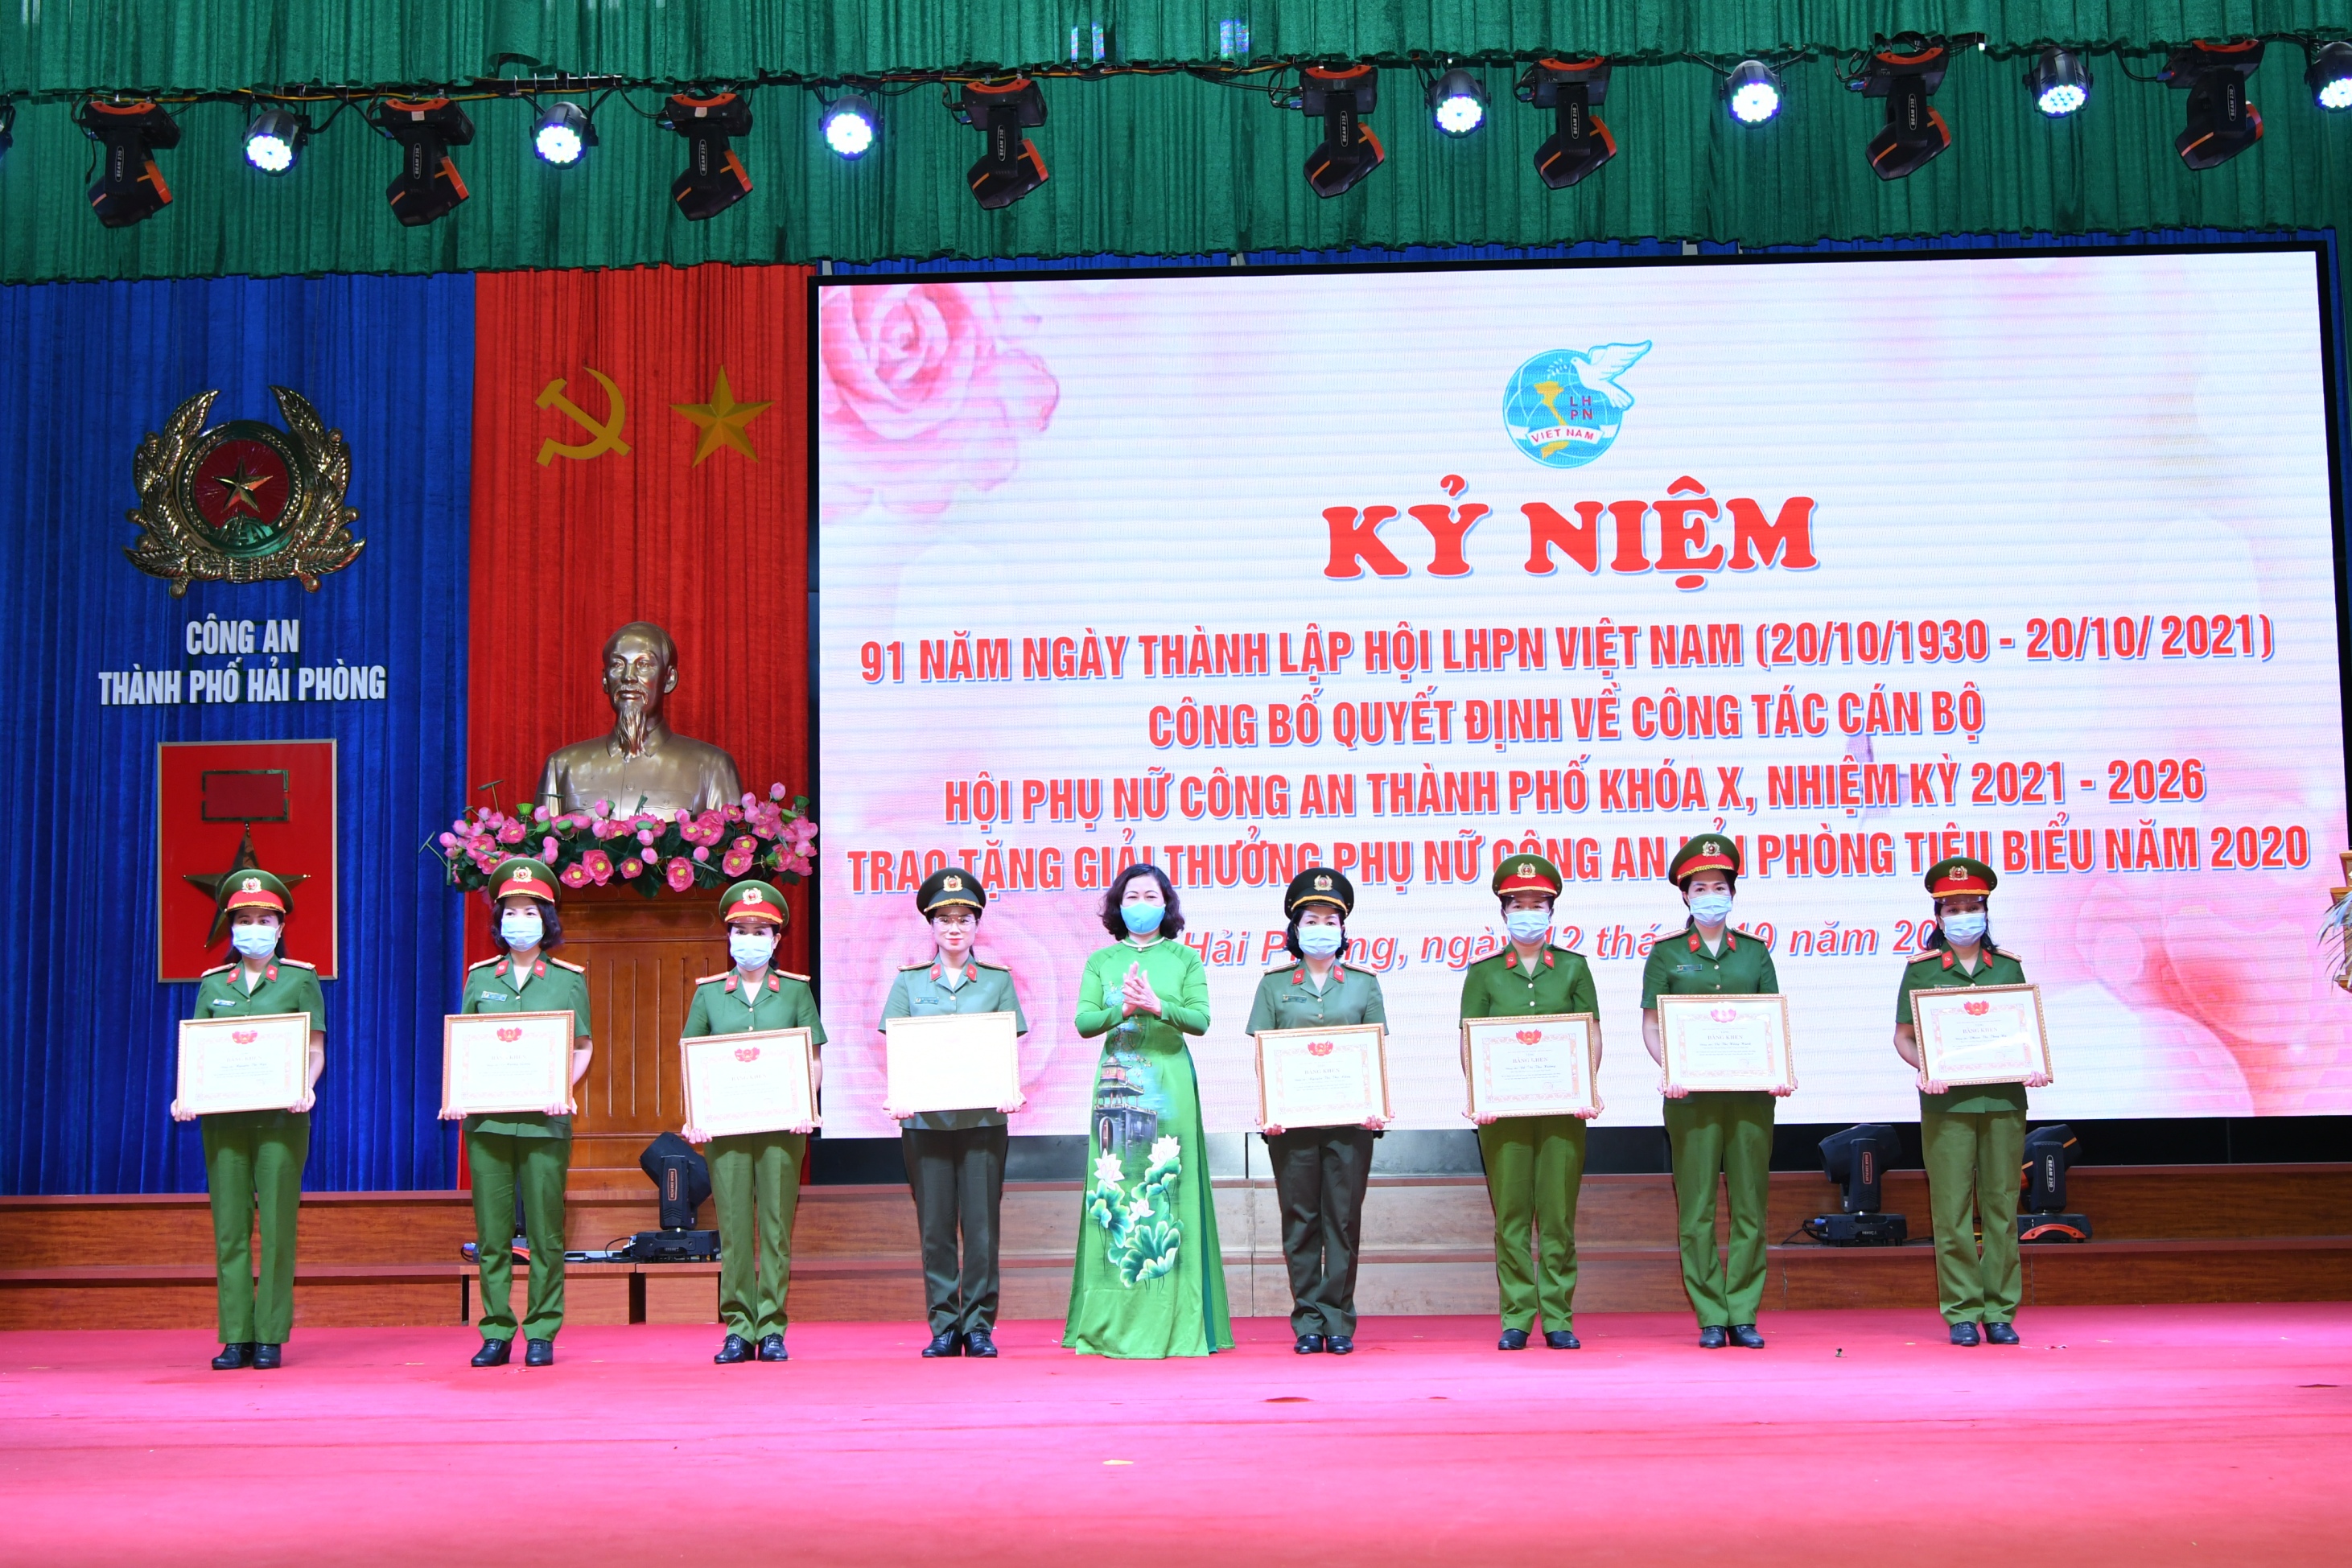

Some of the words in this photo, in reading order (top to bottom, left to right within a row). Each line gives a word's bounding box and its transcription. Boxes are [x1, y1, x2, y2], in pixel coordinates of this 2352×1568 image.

[1566, 428, 1595, 441] NAM
[1322, 474, 1489, 579] KỶ
[1520, 475, 1819, 591] NIỆM
[186, 613, 255, 655] CÔNG
[262, 619, 299, 653] AN
[860, 640, 902, 683] 91
[919, 629, 1011, 681] NĂM
[1022, 627, 1127, 679] NGÀY
[1137, 624, 1268, 677] THÀNH
[1279, 622, 1353, 683] LẬP
[1364, 620, 1431, 681] HỘI
[1442, 627, 1546, 671] LHPN
[1555, 616, 1640, 677] VIỆT
[1649, 623, 1743, 667] NAM
[1755, 618, 1988, 669] (20/10/1930
[1999, 637, 2014, 647] -
[2026, 614, 2152, 660] 20/10/
[2160, 613, 2273, 660] 2021)
[98, 663, 182, 706] THÀNH
[189, 656, 242, 704] PHỐ
[247, 656, 290, 702] HẢI
[298, 658, 387, 702] PHÒNG
[1148, 695, 1256, 748] CÔNG
[1267, 687, 1321, 746] BỐ
[1333, 685, 1455, 749] QUYẾT
[1464, 698, 1560, 751] ĐỊNH
[1570, 681, 1620, 739] VỀ
[1631, 686, 1740, 739] CÔNG
[1750, 684, 1827, 736] TÁC
[1837, 682, 1921, 735] CÁN
[1930, 681, 1983, 743] BỘ
[945, 770, 1011, 832] HỘI
[1022, 778, 1102, 830] PHỤ
[1113, 765, 1173, 820] NỮ
[1180, 766, 1289, 819] CÔNG
[1299, 773, 1355, 817] AN
[1365, 762, 1498, 815] THÀNH
[1508, 753, 1588, 813] PHỐ
[1599, 757, 1707, 811] KHÓA
[1716, 766, 1756, 813] X,
[1767, 754, 1899, 817] NHIỆM
[1909, 752, 1959, 805] KỲ
[1971, 760, 2064, 805] 2021
[2079, 779, 2095, 789] -
[2107, 757, 2206, 802] 2026
[958, 838, 1062, 900] TẶNG
[1163, 824, 1320, 887] THƯỞNG
[1333, 840, 1412, 893] PHỤ
[1423, 829, 1484, 883] NỮ
[1610, 836, 1666, 879] AN
[1757, 822, 1894, 877] PHÒNG
[2002, 811, 2094, 873] BIỂU
[2104, 818, 2199, 870] NĂM
[2210, 825, 2309, 869] 2020
[1261, 930, 1407, 970] Png,
[1420, 925, 1510, 969] ngà
[1789, 920, 1878, 954] năm
